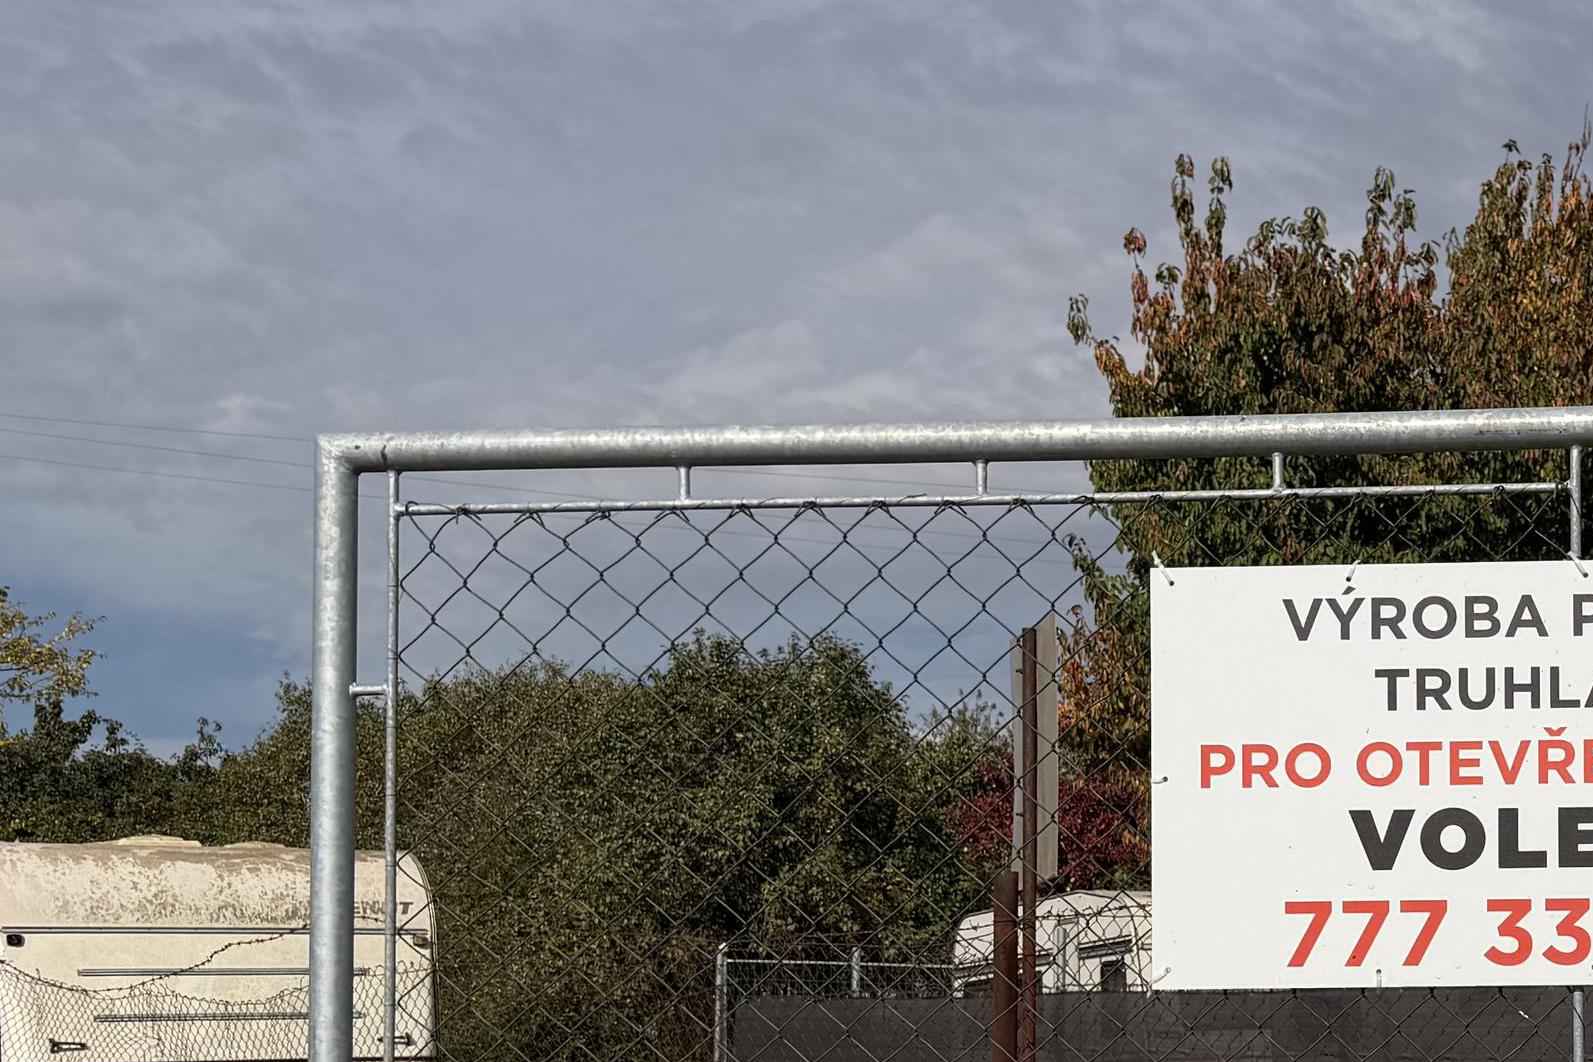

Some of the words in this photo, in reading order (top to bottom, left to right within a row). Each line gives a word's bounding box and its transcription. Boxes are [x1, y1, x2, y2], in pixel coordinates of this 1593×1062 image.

[1283, 586, 1549, 641] VÝROBA
[1201, 742, 1332, 788] PRO
[1284, 900, 1448, 967] 777
